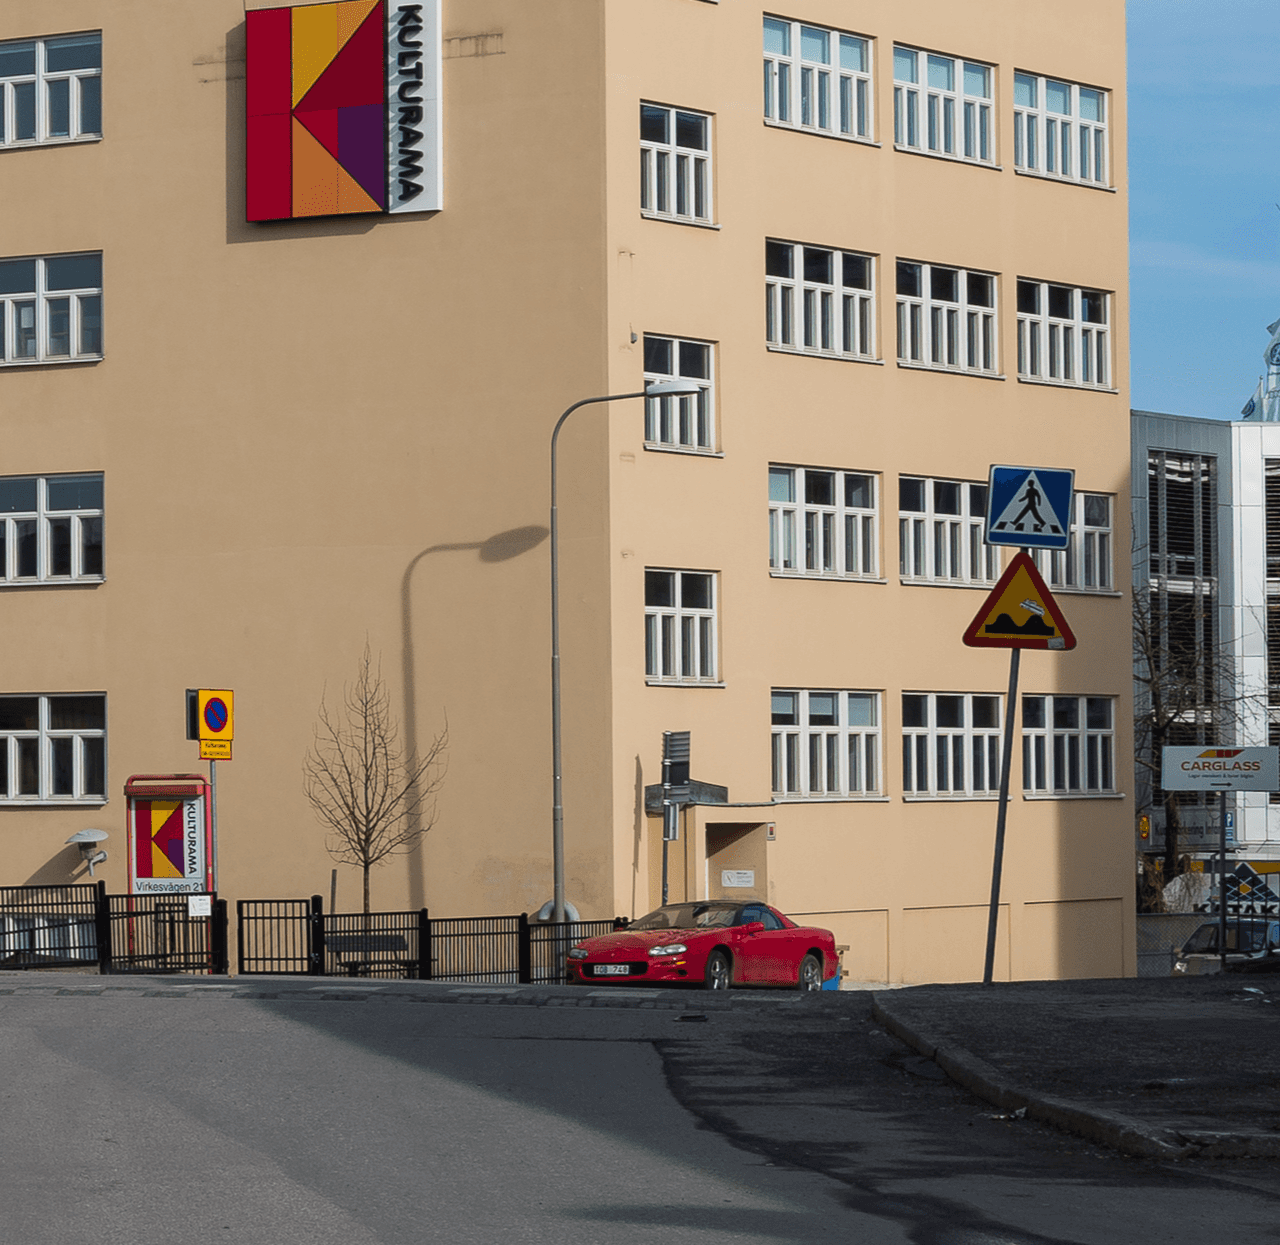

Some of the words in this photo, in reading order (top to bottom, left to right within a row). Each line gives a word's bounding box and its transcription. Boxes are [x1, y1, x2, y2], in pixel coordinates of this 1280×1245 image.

[397, 4, 424, 202] KULTURAMA
[1180, 760, 1261, 771] CARGLASS
[187, 802, 197, 874] KULTURAMA
[192, 882, 204, 892] 21
